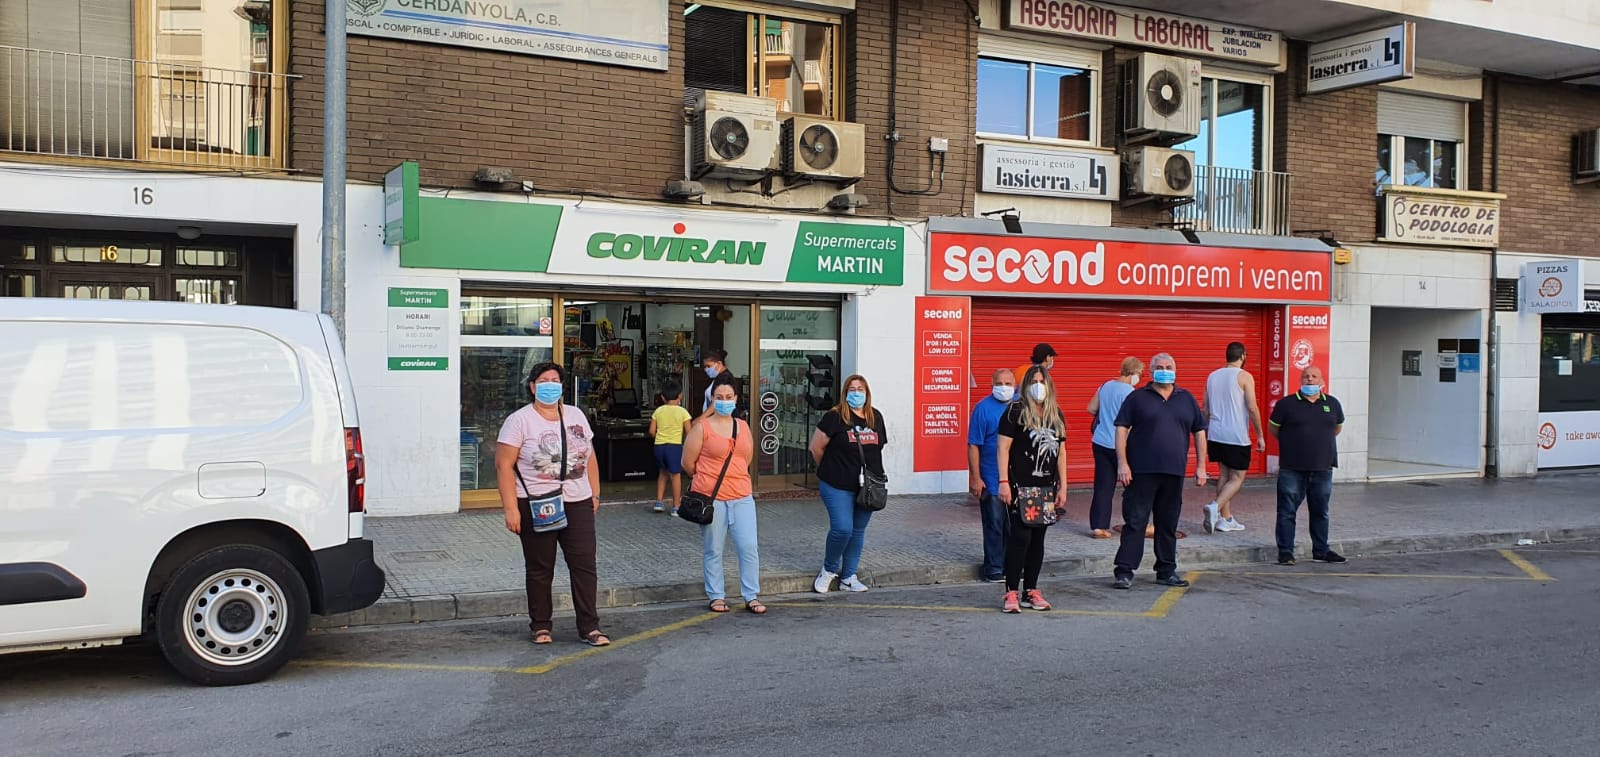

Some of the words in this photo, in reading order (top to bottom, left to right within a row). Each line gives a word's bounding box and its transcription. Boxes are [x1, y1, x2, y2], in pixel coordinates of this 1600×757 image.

[536, 13, 561, 27] C.B.
[1020, 0, 1117, 37] ASESORIA
[1134, 13, 1214, 52] LABORAL
[383, 22, 441, 37] COMPTABLE
[492, 36, 535, 48] LABORAL
[543, 42, 612, 57] ASSEGURANCES
[614, 50, 658, 63] GENERALS
[1222, 47, 1247, 57] VARIOS
[1049, 160, 1075, 169] gestió
[133, 186, 153, 205] 16
[1409, 203, 1471, 219] CENTRO
[1476, 208, 1496, 220] DE
[1409, 219, 1494, 236] PODOLOGIA
[586, 223, 767, 267] COVIRAN
[803, 231, 898, 252] Supermercats
[100, 245, 118, 261] 16
[817, 255, 884, 275] MARTIN
[943, 242, 1105, 286] second
[1117, 261, 1231, 293] comprem
[1238, 260, 1244, 288] i
[1251, 266, 1323, 292] venem
[1536, 265, 1568, 274] PIZZAS
[923, 308, 962, 319] second
[1292, 313, 1328, 325] second
[1565, 430, 1585, 441] take
